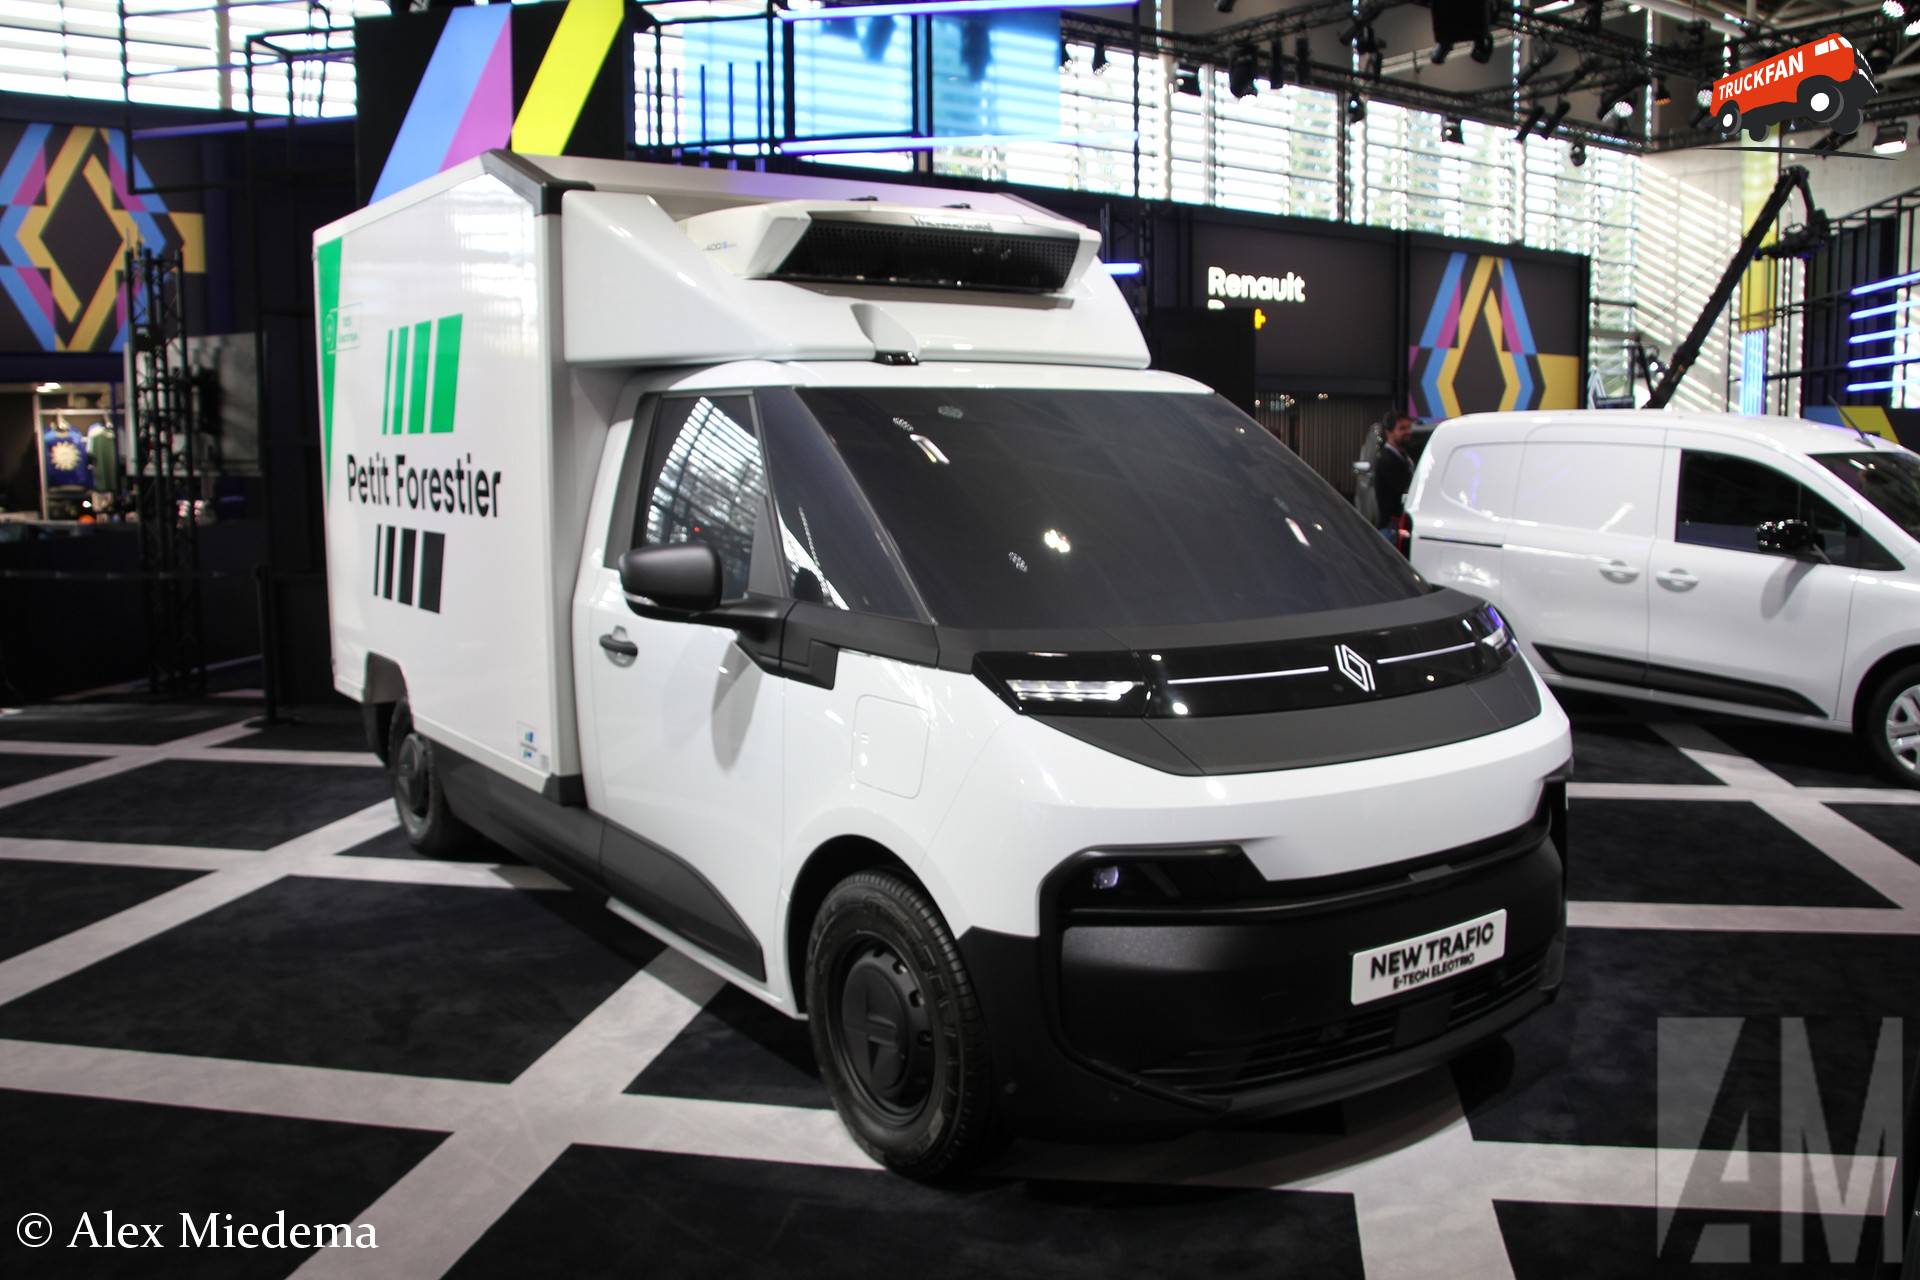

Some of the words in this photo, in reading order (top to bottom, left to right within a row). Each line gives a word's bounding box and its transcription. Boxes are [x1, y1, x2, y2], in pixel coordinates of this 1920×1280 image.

[1207, 266, 1306, 302] Renault
[347, 451, 390, 506] Petit
[395, 452, 501, 518] Forestier
[1370, 944, 1422, 981] NEW
